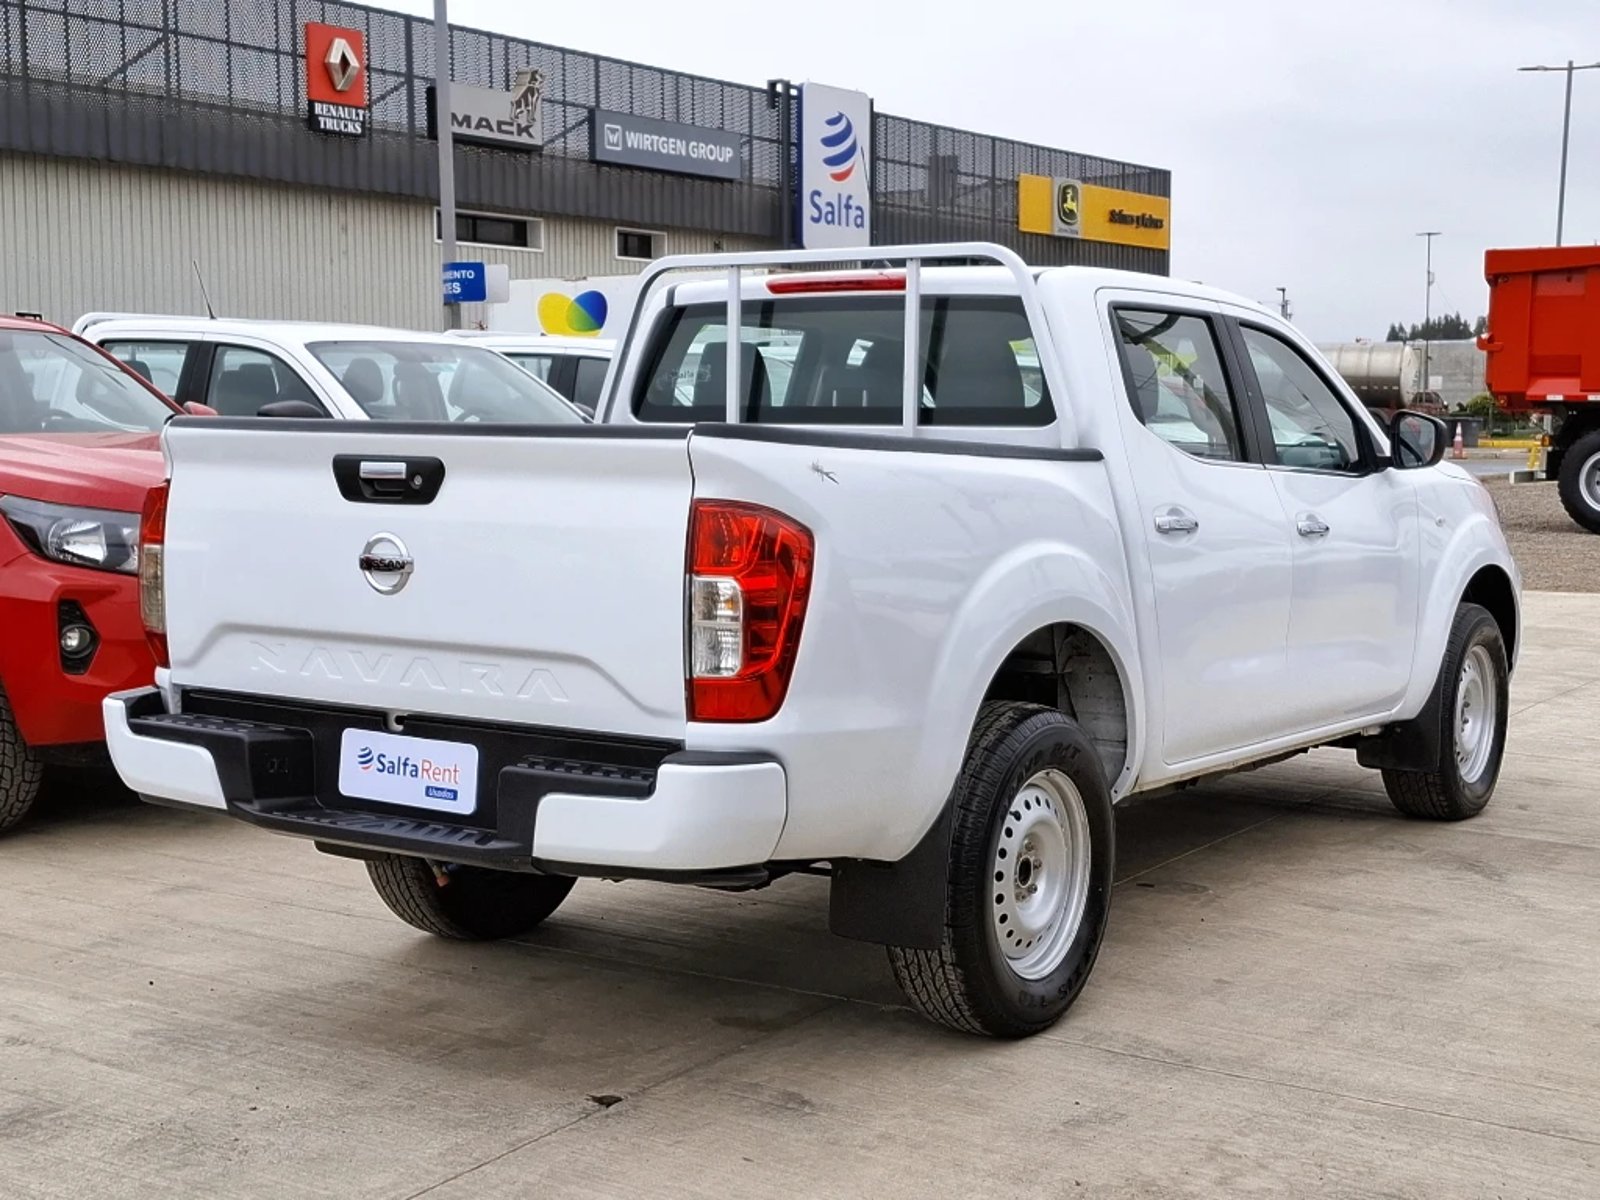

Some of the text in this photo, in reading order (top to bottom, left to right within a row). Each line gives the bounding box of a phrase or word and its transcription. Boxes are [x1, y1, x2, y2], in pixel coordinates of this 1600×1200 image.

[314, 102, 364, 121] RENAULT
[318, 116, 362, 134] TRUCKS
[451, 112, 535, 139] MACK
[625, 131, 733, 162] WIRTGEN GROUP
[810, 189, 865, 229] Salfa
[249, 640, 569, 702] NAVARA
